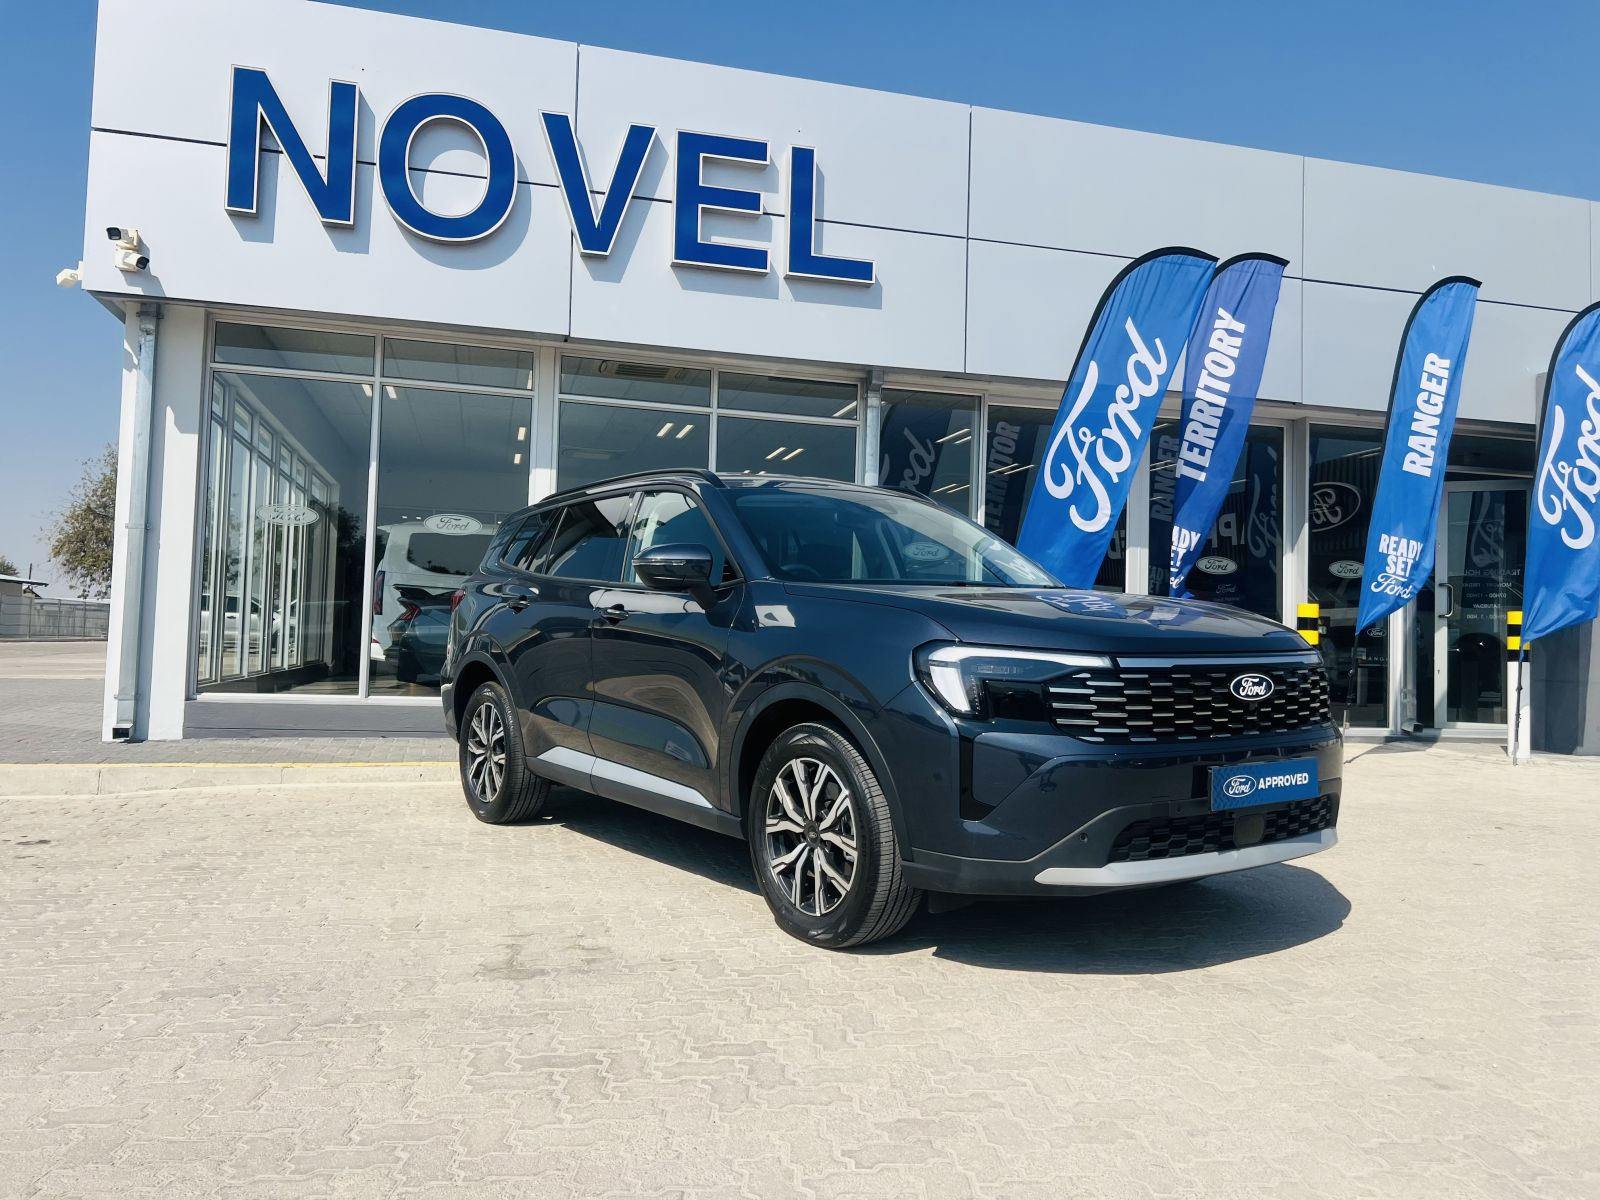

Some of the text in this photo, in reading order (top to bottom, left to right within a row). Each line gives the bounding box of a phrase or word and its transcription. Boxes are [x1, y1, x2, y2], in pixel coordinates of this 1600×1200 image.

[224, 63, 876, 287] NOVEL
[1176, 307, 1246, 482] TERRITORY
[1044, 316, 1168, 533] Ford
[1402, 352, 1451, 478] RANGER
[272, 504, 308, 521] Ford
[437, 516, 471, 532] Ford
[912, 545, 940, 558] Ford
[1378, 533, 1424, 562] READY
[1204, 557, 1231, 572] Ford
[1337, 561, 1361, 575] Ford
[1385, 553, 1414, 578] SET
[1371, 572, 1411, 599] Ford
[1239, 677, 1267, 697] Ford
[1228, 772, 1309, 795] Ford APPROVED
